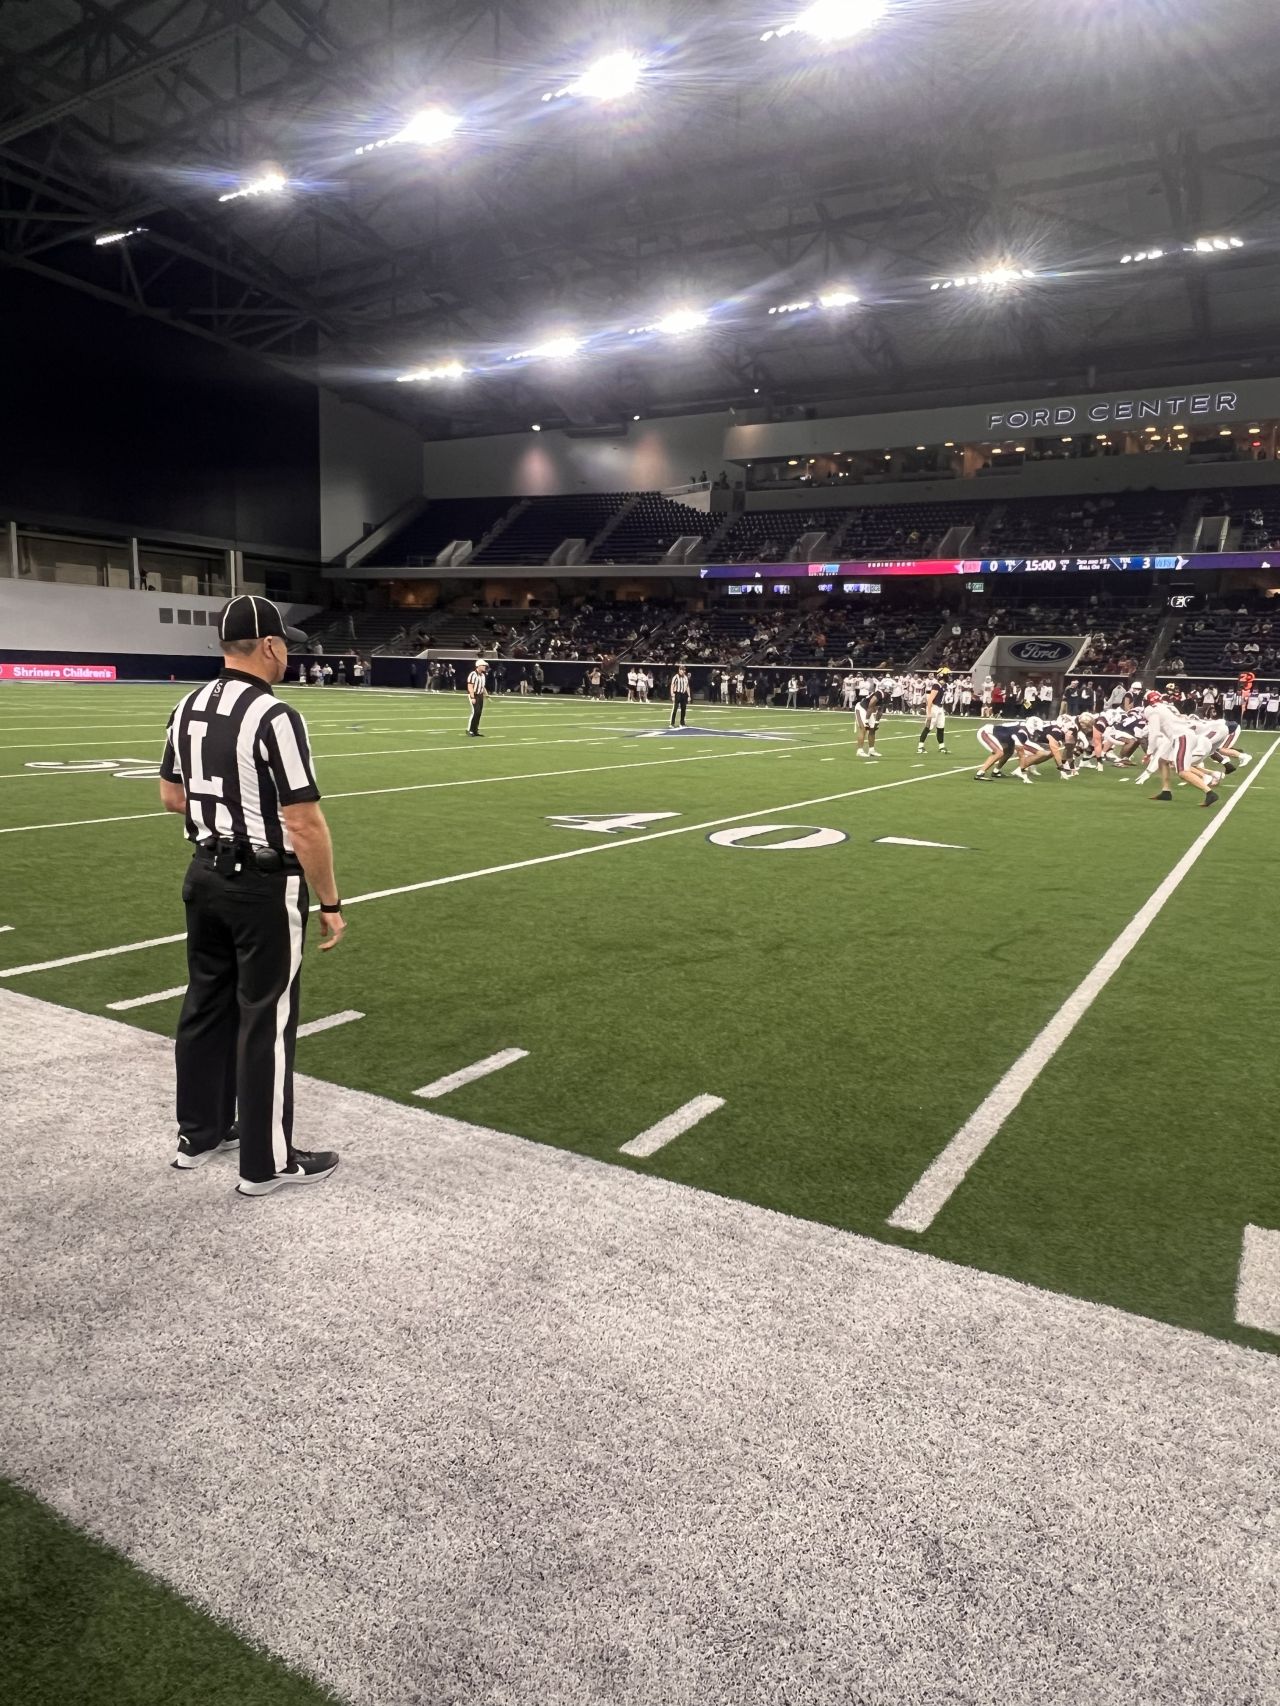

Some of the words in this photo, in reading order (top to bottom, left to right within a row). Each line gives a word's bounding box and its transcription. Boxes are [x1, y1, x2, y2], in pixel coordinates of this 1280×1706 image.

[987, 407, 1076, 430] FORD
[1088, 392, 1237, 421] CENTER
[989, 560, 999, 572] 0
[1025, 559, 1057, 572] 15:00
[1142, 557, 1151, 569] 3
[1020, 642, 1061, 659] Ford
[13, 667, 60, 677] Shriners
[187, 720, 223, 798] L
